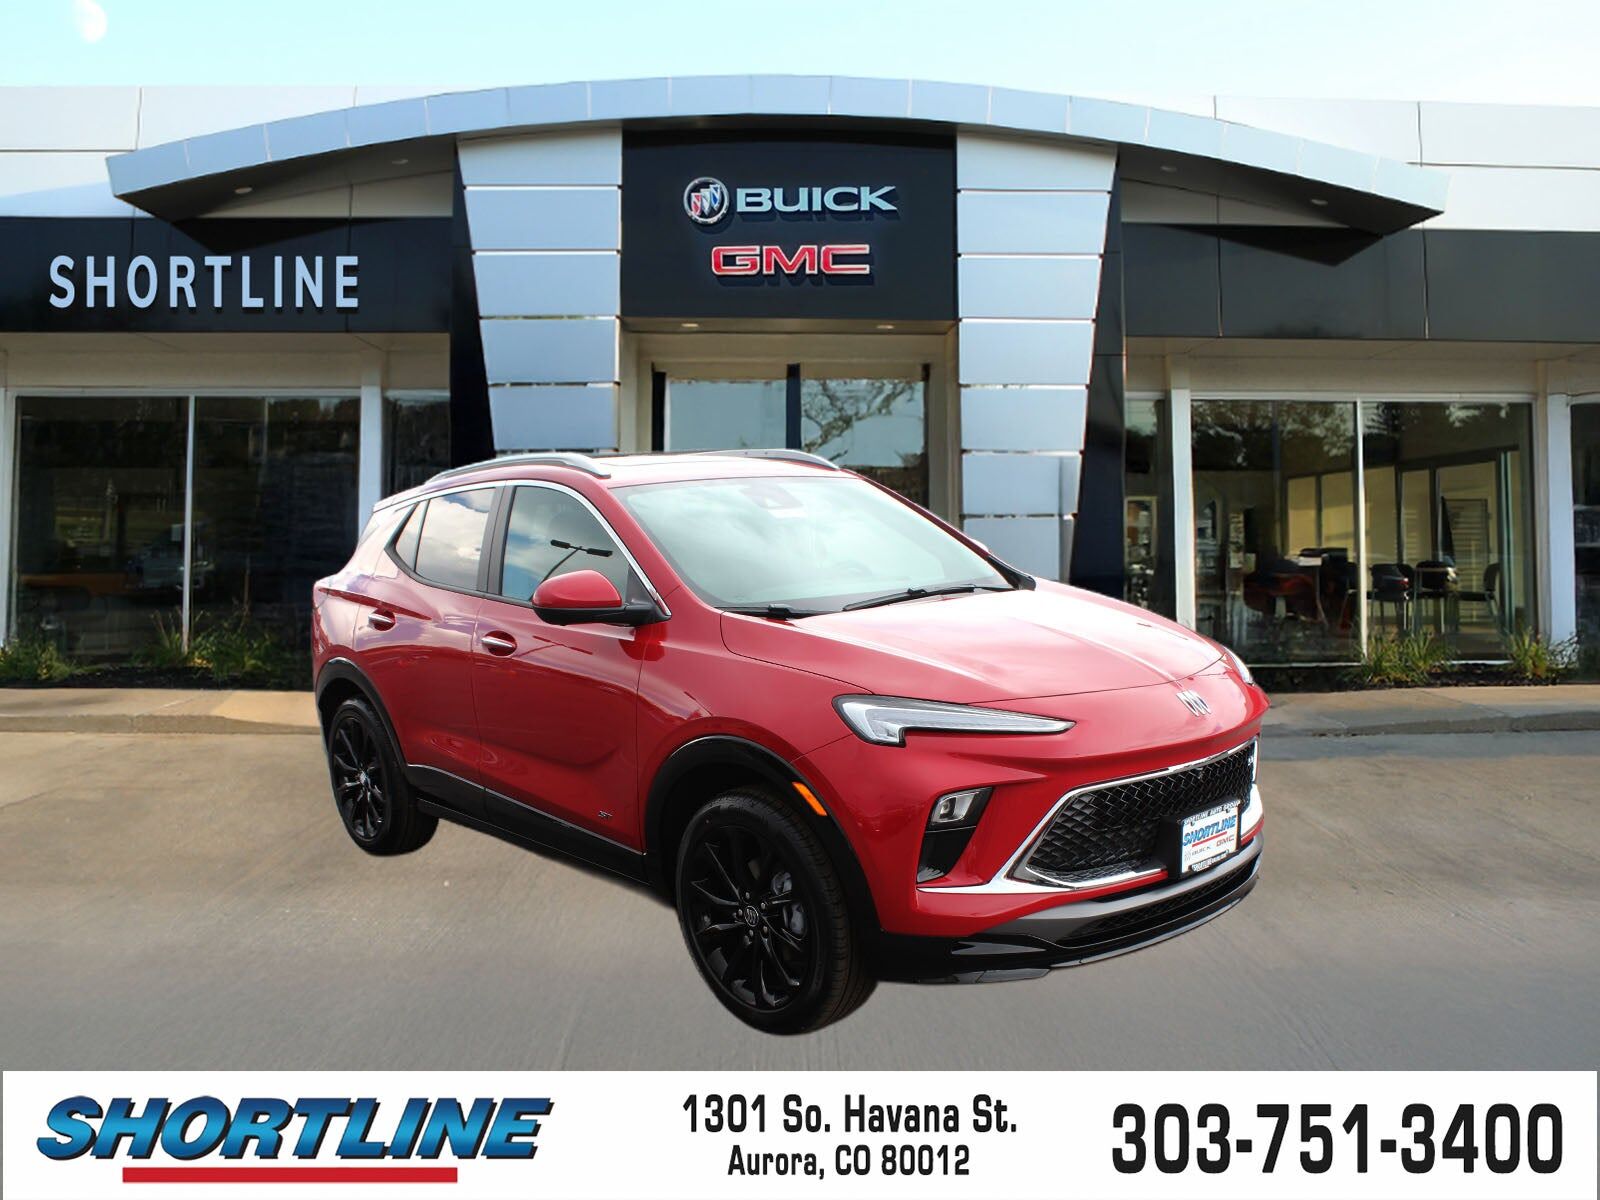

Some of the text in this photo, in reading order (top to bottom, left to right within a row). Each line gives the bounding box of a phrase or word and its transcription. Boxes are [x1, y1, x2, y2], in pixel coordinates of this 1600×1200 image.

[736, 186, 898, 213] BUICK
[711, 244, 870, 276] GMC
[49, 255, 359, 309] SHORTLINE
[1183, 815, 1237, 847] SHORTLINE
[1192, 835, 1235, 856] BUICK GMC
